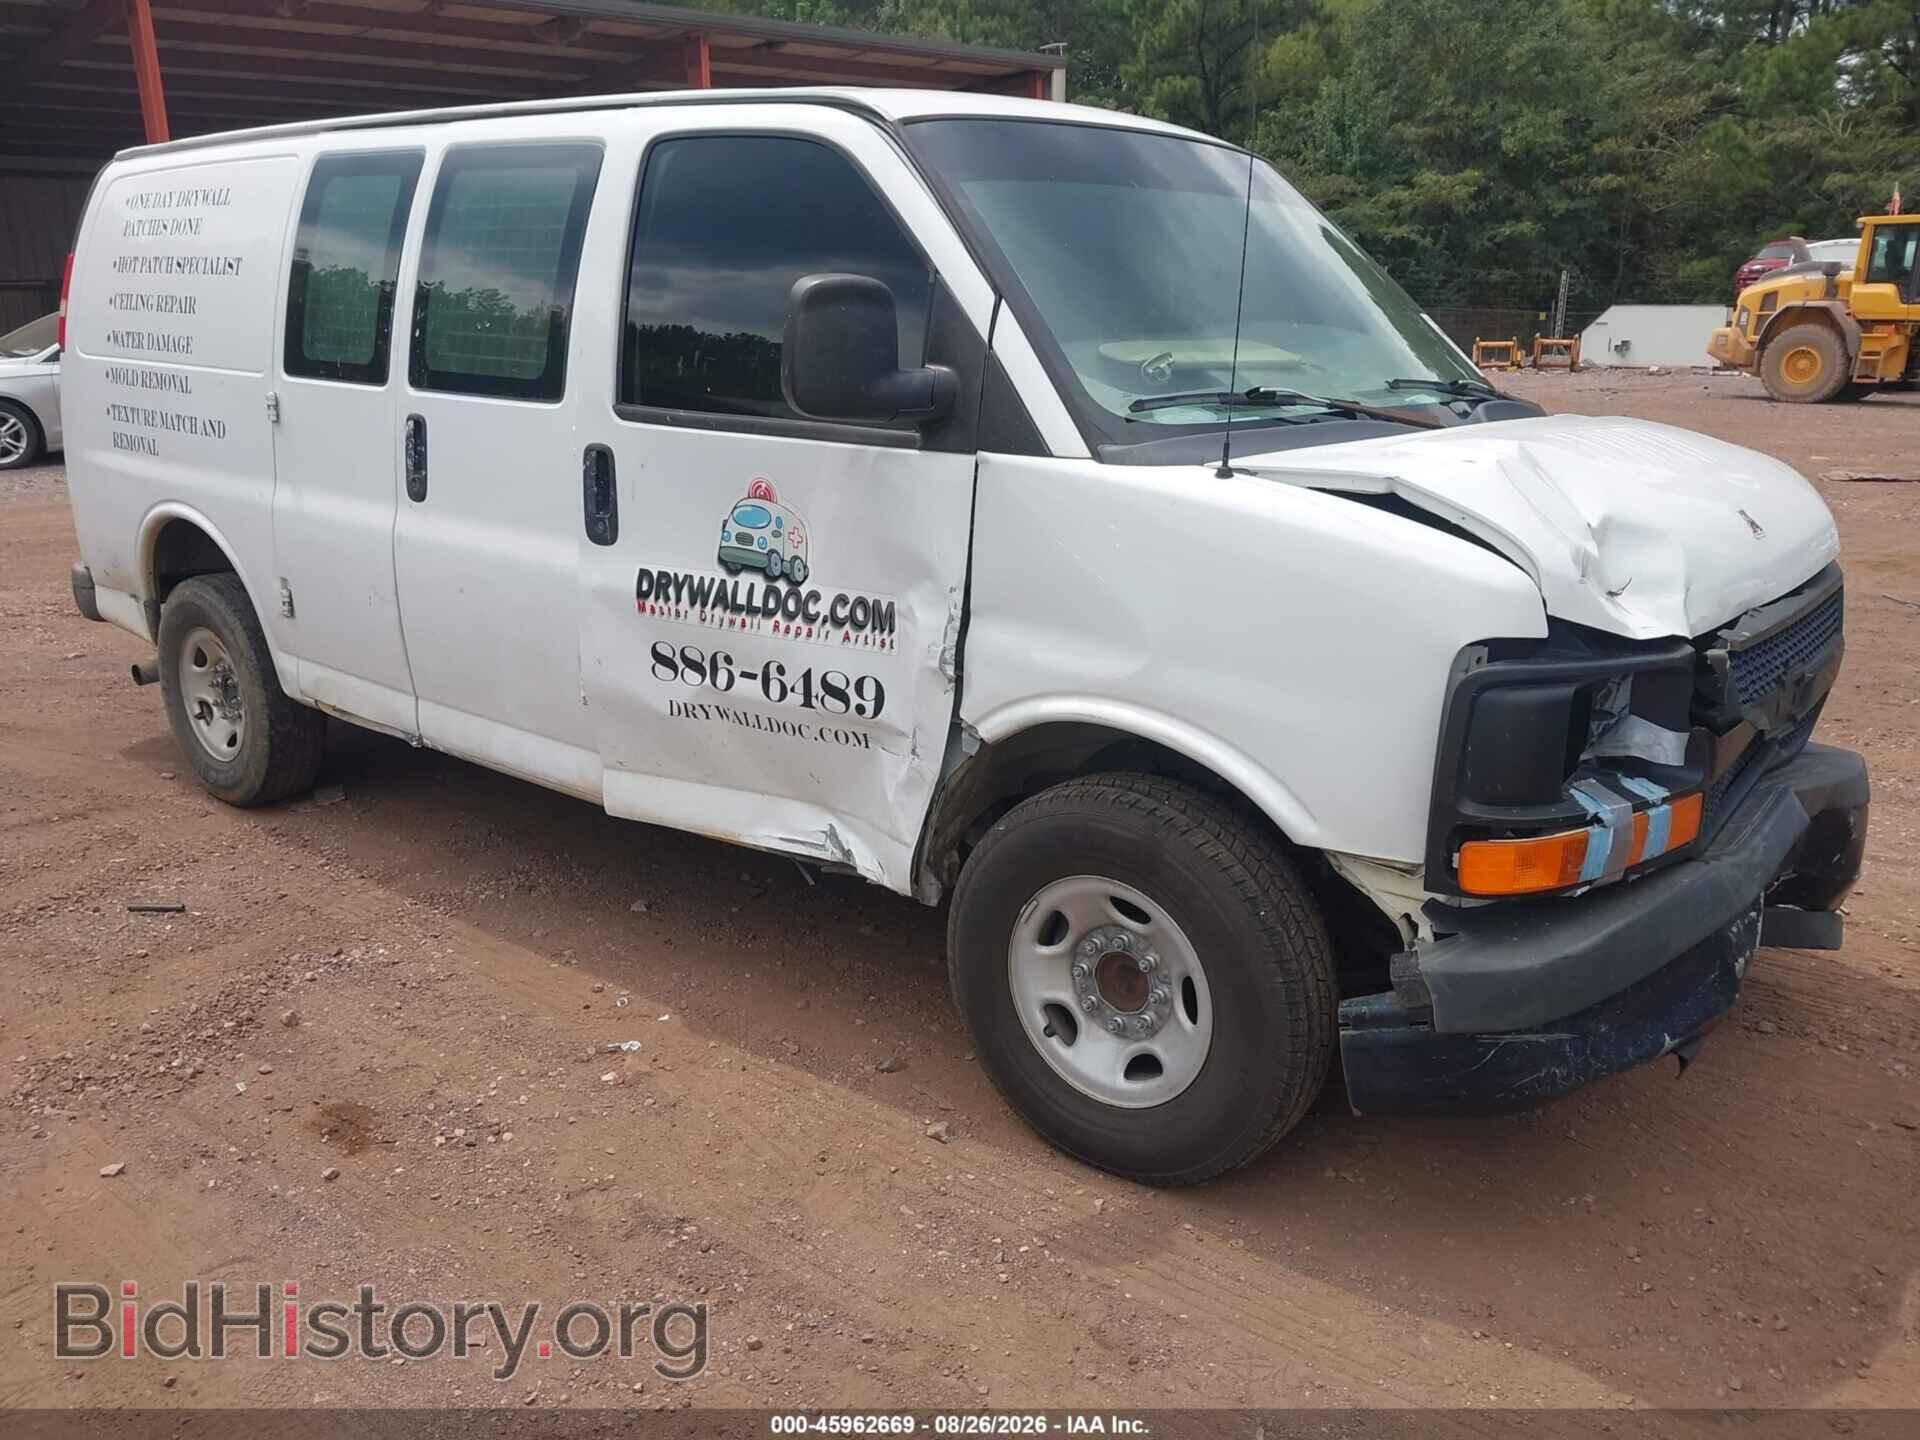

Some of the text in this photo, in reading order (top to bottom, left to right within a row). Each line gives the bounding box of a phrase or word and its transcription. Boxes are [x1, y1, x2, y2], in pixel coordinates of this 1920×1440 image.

[176, 187, 232, 208] DRYWALL
[123, 217, 203, 237] PATCHES DONE
[117, 255, 243, 276] HOT PATCH SPECIALIST
[113, 293, 197, 315] CEILING REPAIR
[112, 330, 193, 355] WATER DAMAGE
[110, 367, 192, 395] MOLD REMOVAL
[111, 404, 226, 440] TEXTURE MATCH AND
[112, 432, 160, 457] REMOVAL
[635, 567, 897, 637] DRYWALLDOC.COM
[636, 599, 895, 651] Master Drywall Repair Artist
[650, 640, 886, 721] 886-6489
[668, 699, 871, 750] DRYWALLDOC.COM
